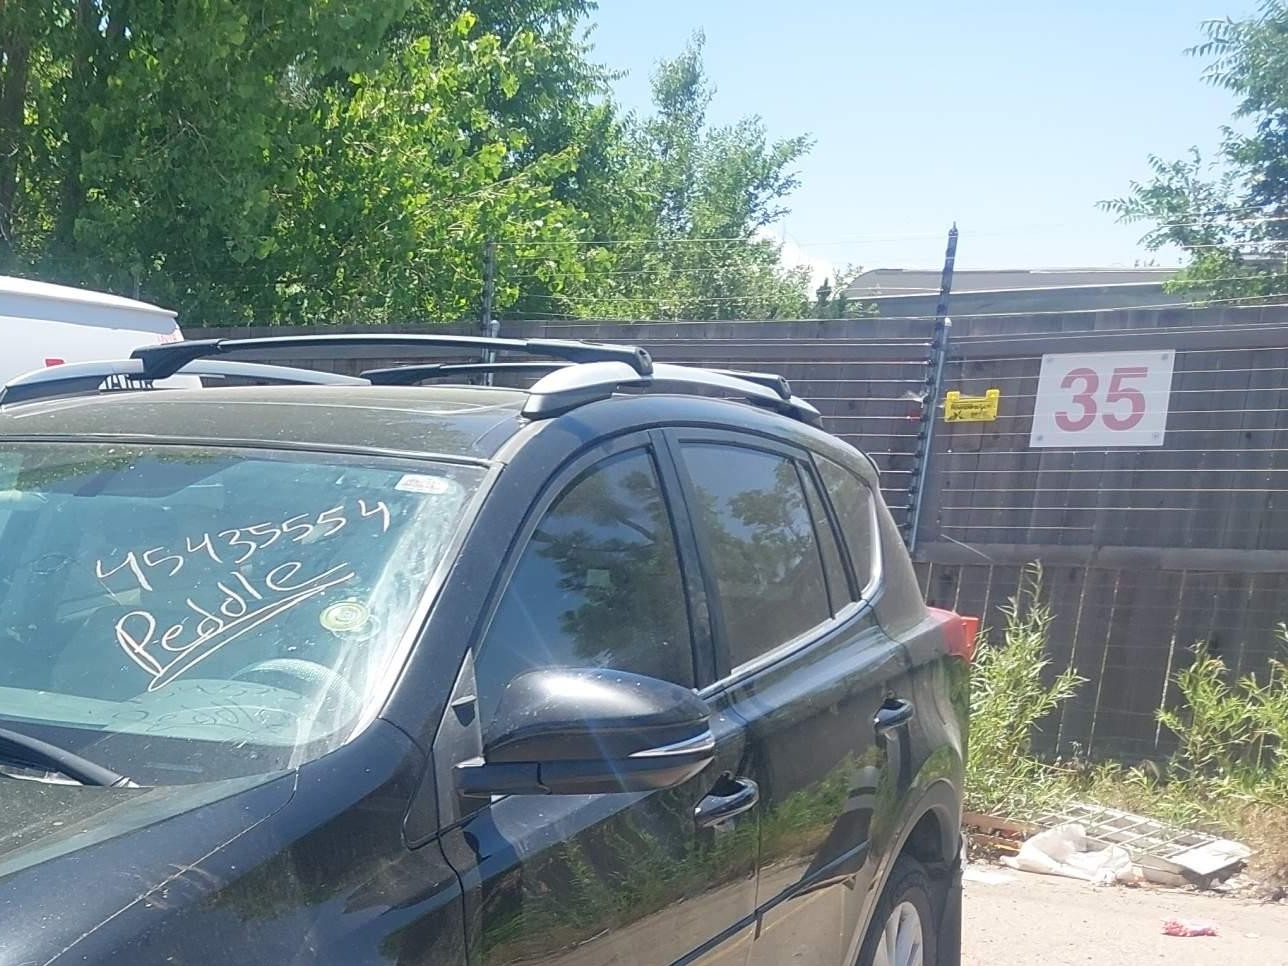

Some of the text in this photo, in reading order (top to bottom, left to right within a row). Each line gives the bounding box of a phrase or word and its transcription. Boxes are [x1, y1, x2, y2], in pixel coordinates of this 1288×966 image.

[1054, 366, 1149, 432] 35
[95, 498, 391, 592] 45435554
[115, 561, 349, 678] Peddle
